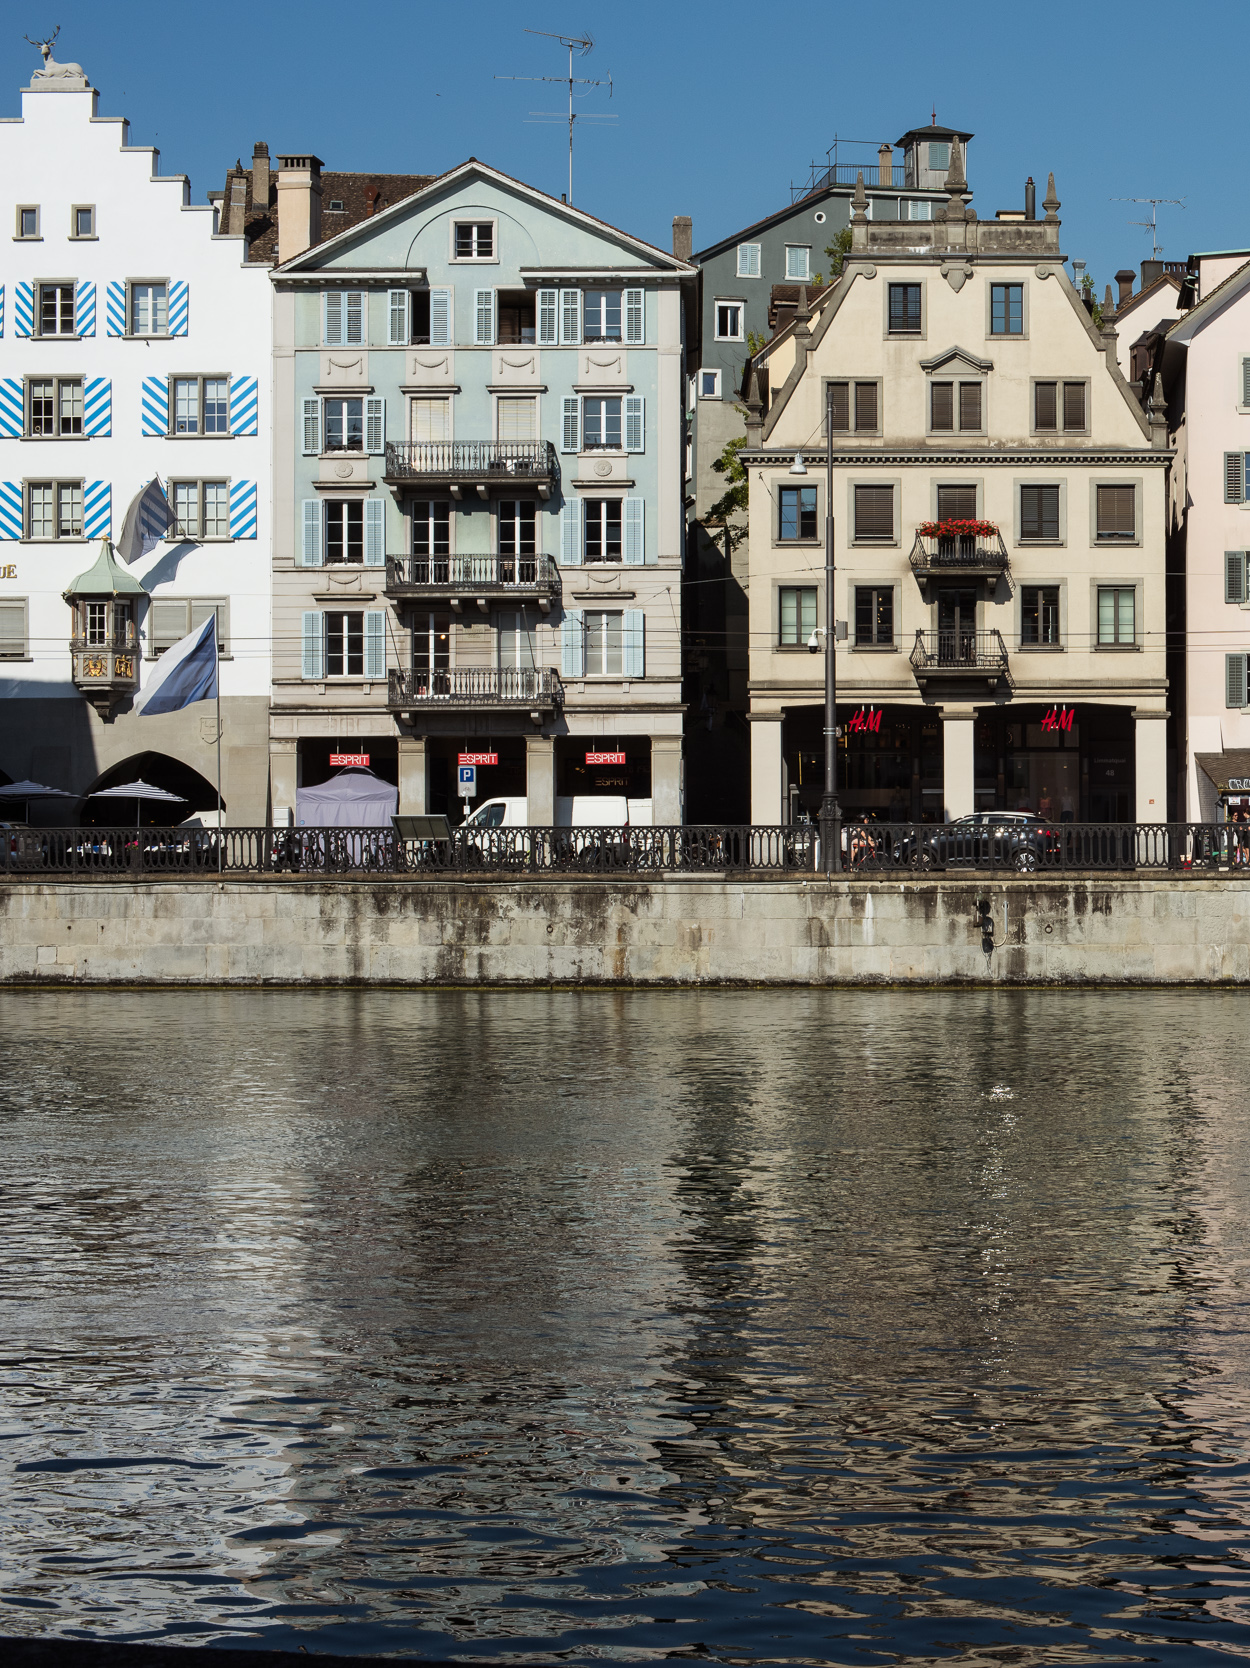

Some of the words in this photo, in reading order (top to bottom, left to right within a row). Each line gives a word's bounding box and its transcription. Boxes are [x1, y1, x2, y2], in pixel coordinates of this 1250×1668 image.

[848, 710, 883, 733] H&M
[1040, 709, 1075, 732] H&M
[331, 755, 369, 765] ESPRIT
[459, 754, 497, 764] ESPRIT
[587, 753, 625, 763] ESPRIT
[463, 769, 471, 781] P
